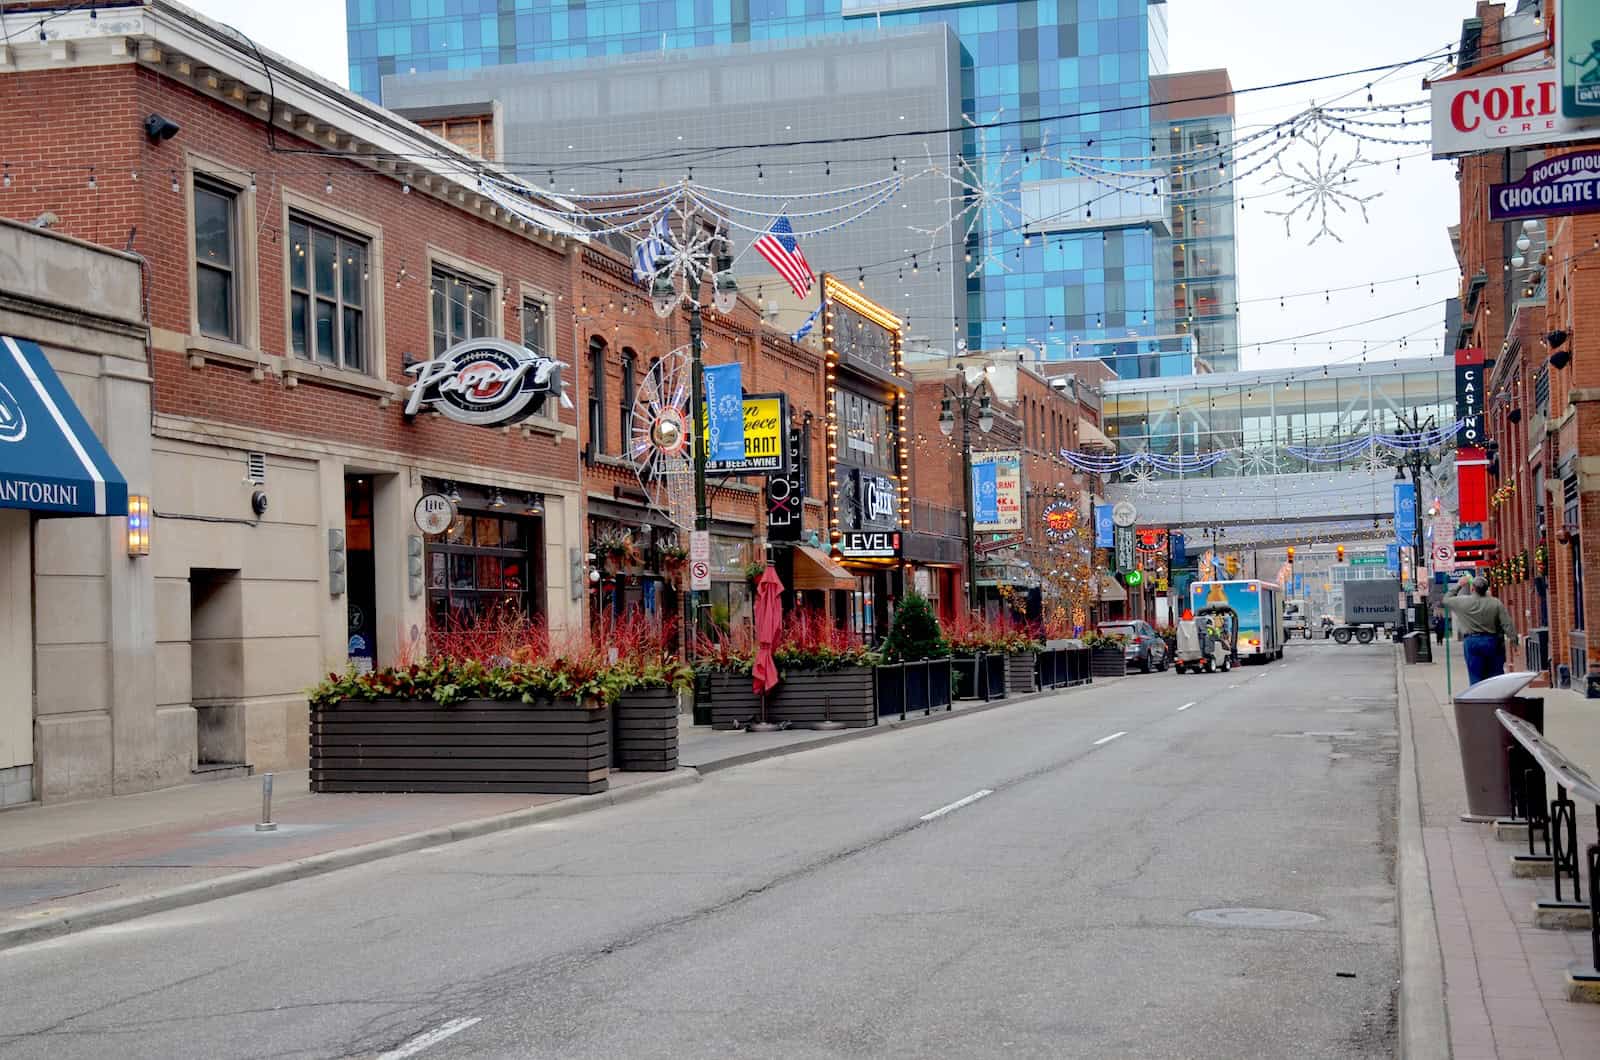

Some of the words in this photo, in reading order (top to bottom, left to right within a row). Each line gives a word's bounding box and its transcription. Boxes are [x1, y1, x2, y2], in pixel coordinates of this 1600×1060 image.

[1532, 158, 1569, 185] ROCKY
[1499, 181, 1593, 211] CHOCOLATE
[1464, 370, 1476, 439] CASINO
[753, 457, 777, 467] WINE
[790, 434, 799, 518] LOUNGE
[425, 499, 445, 513] Lite
[1050, 520, 1072, 529] PIZZA
[842, 533, 893, 550] LEVEL
